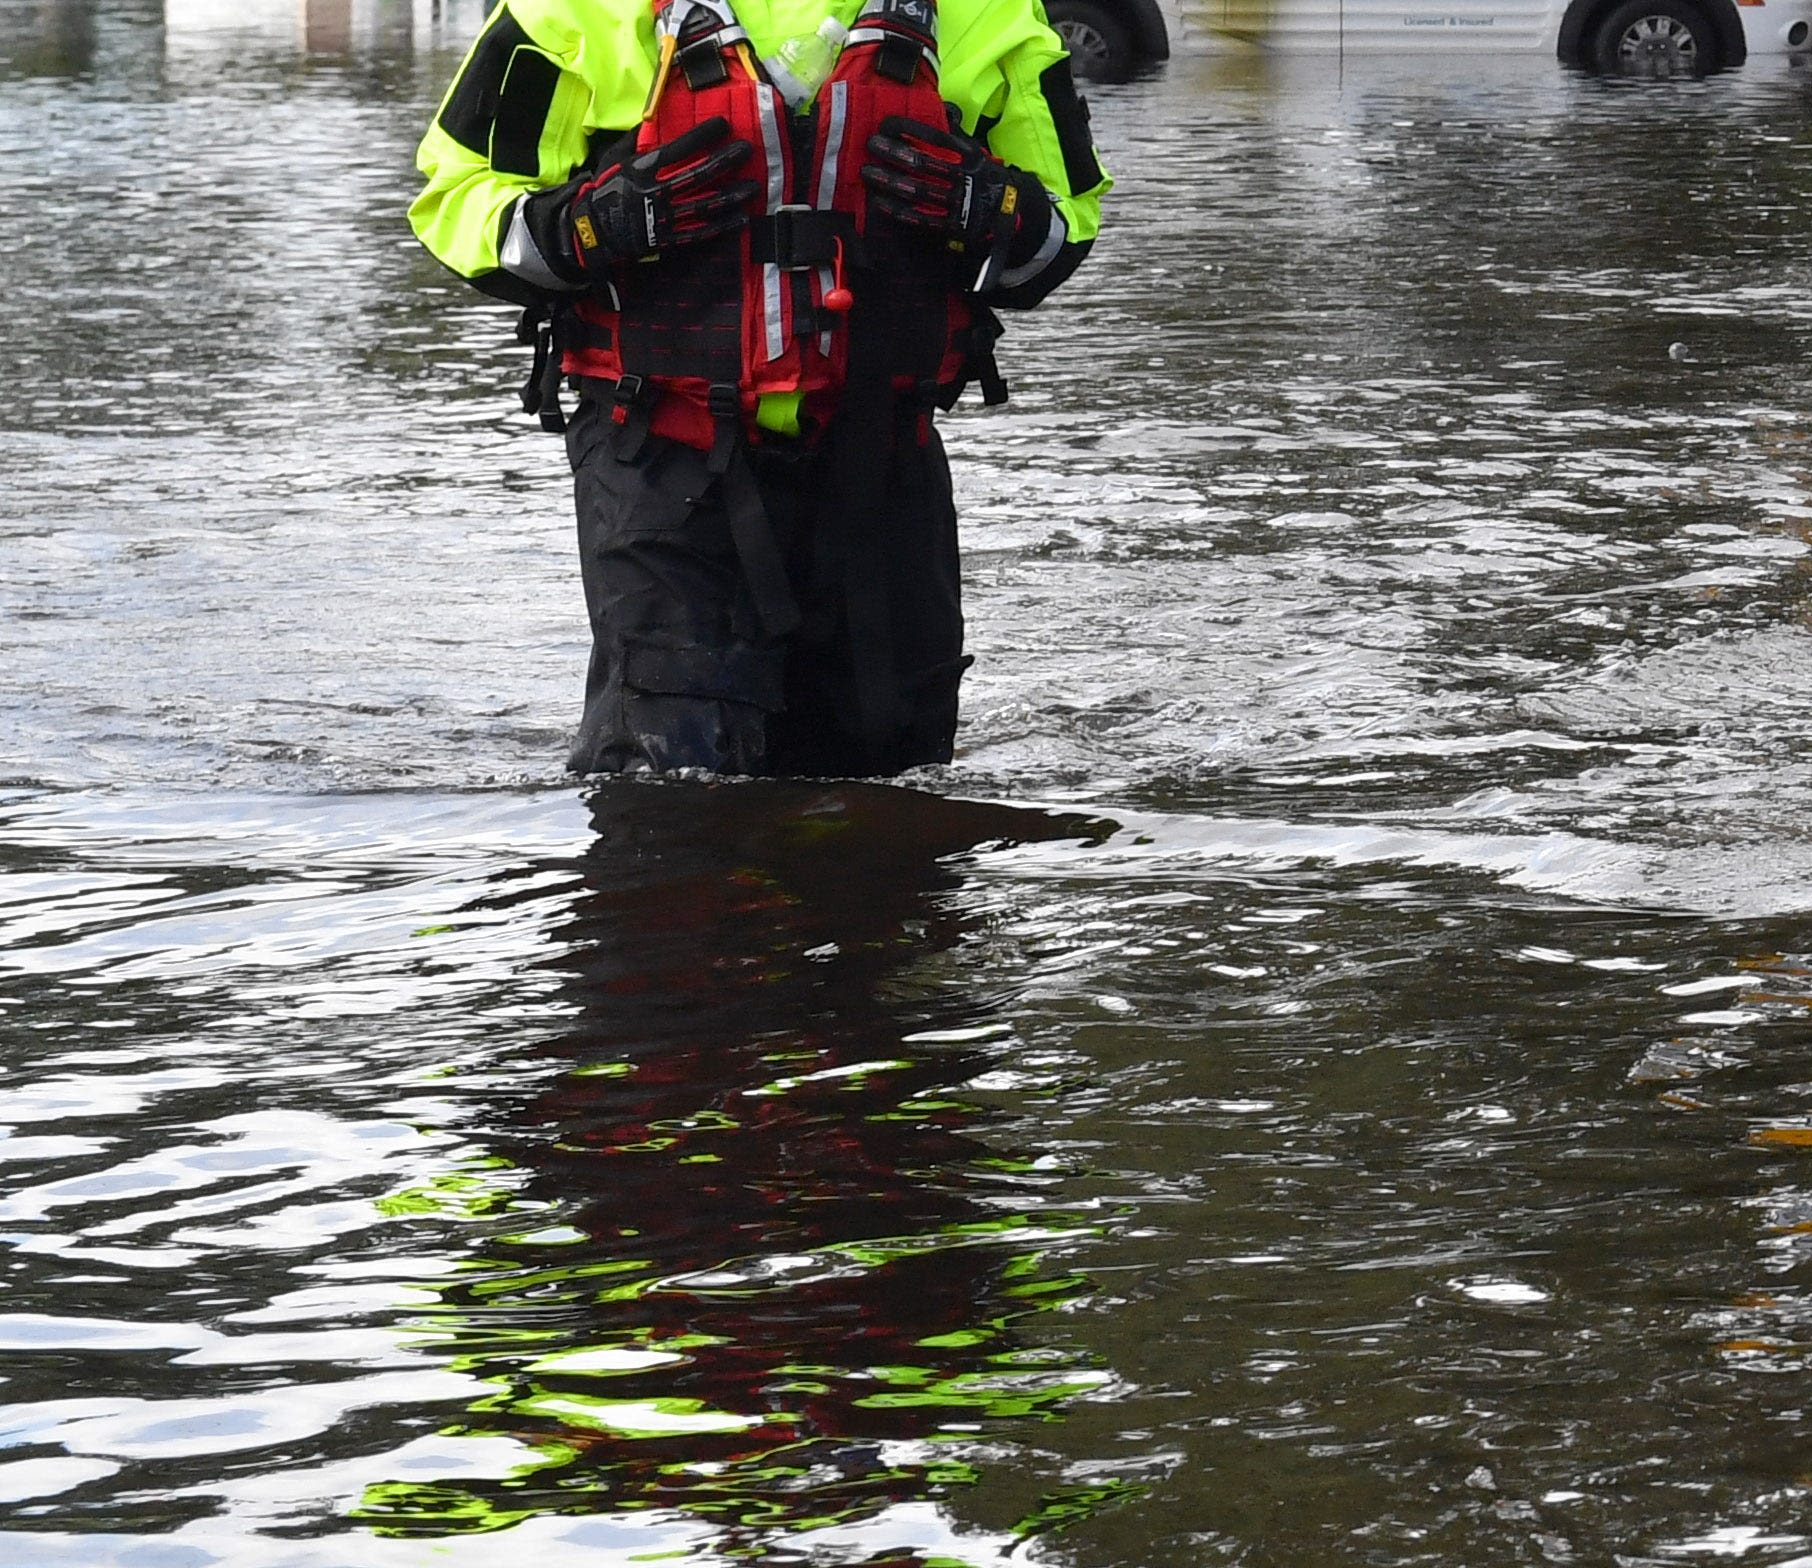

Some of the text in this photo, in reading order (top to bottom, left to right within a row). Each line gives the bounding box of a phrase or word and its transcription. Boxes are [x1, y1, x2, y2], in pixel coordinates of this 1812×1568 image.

[1404, 16, 1495, 26] Licensed & Insured
